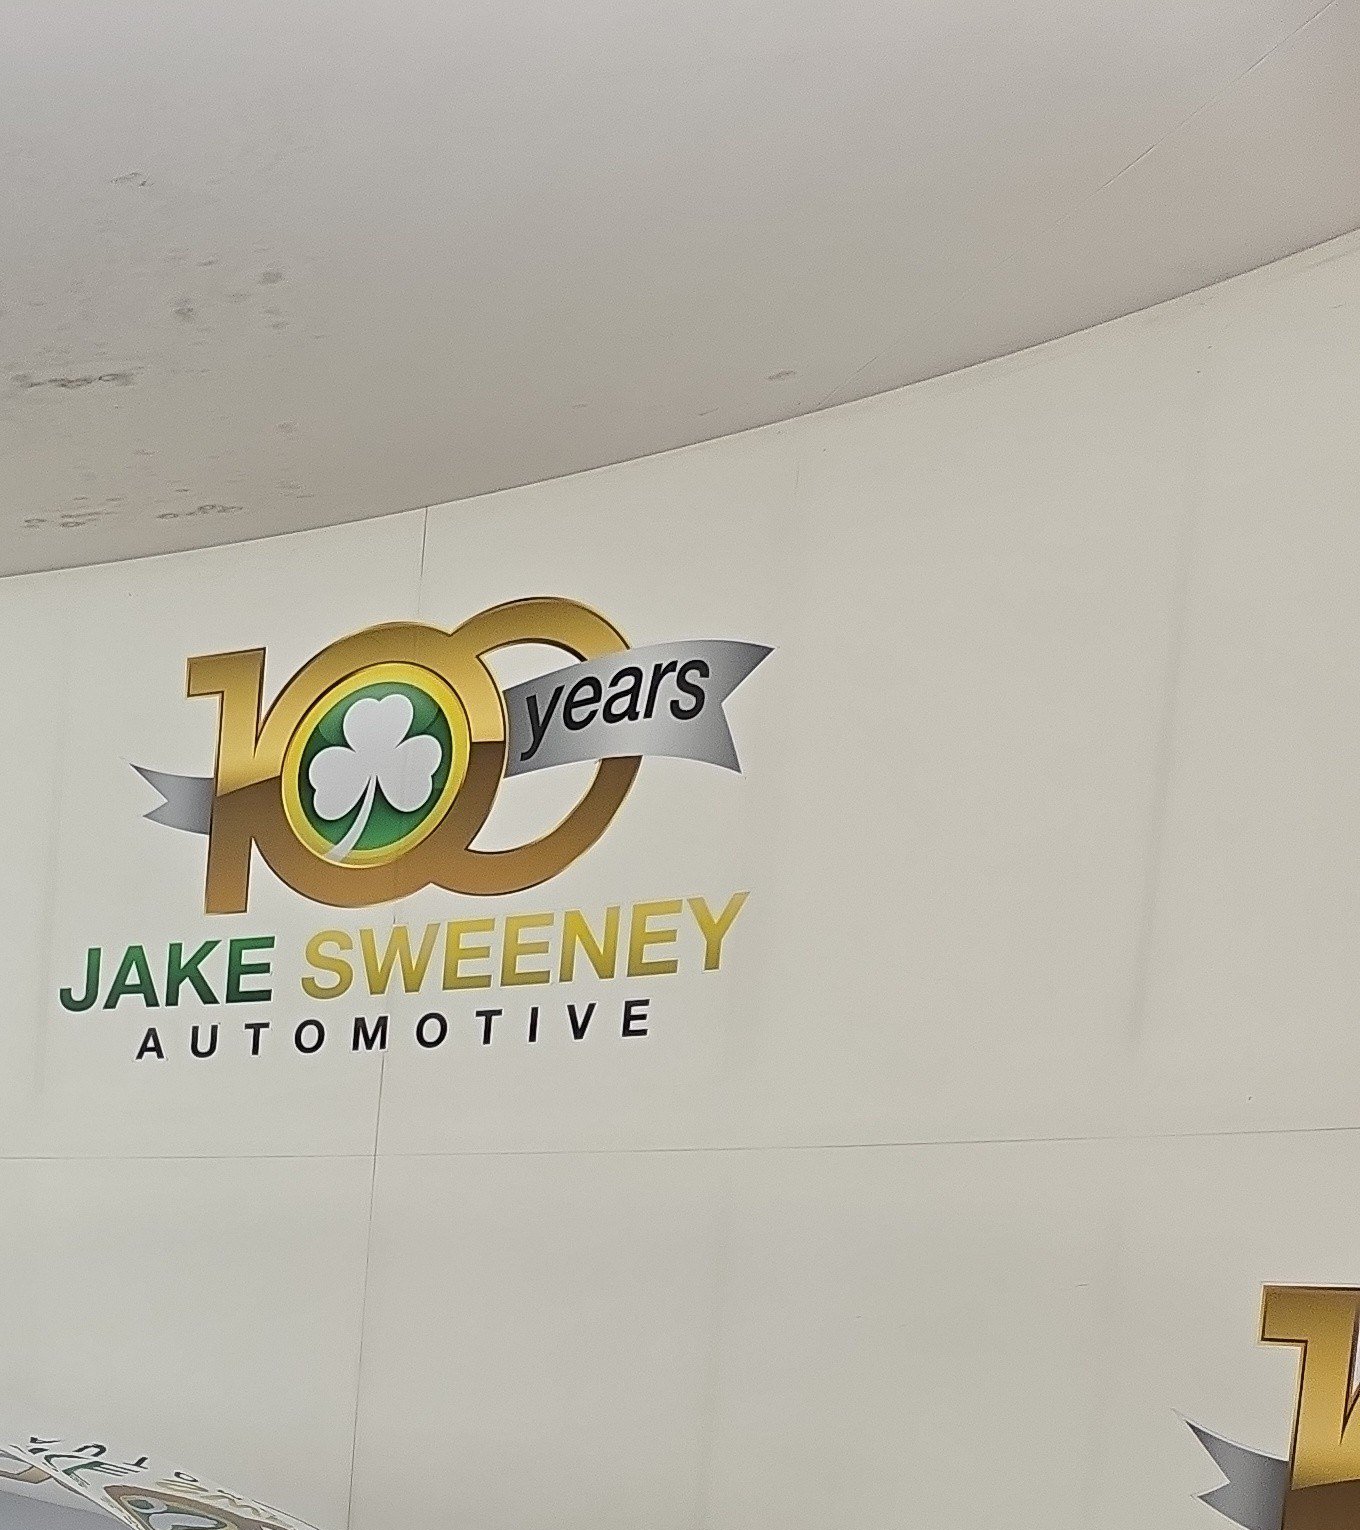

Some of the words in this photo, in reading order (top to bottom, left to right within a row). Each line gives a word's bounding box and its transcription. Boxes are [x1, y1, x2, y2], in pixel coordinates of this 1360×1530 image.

[186, 596, 644, 915] 100
[520, 656, 710, 762] years
[59, 936, 275, 1013] JAKE
[301, 891, 750, 1001] SWEENEY
[136, 998, 652, 1060] AUTOMOTIVE
